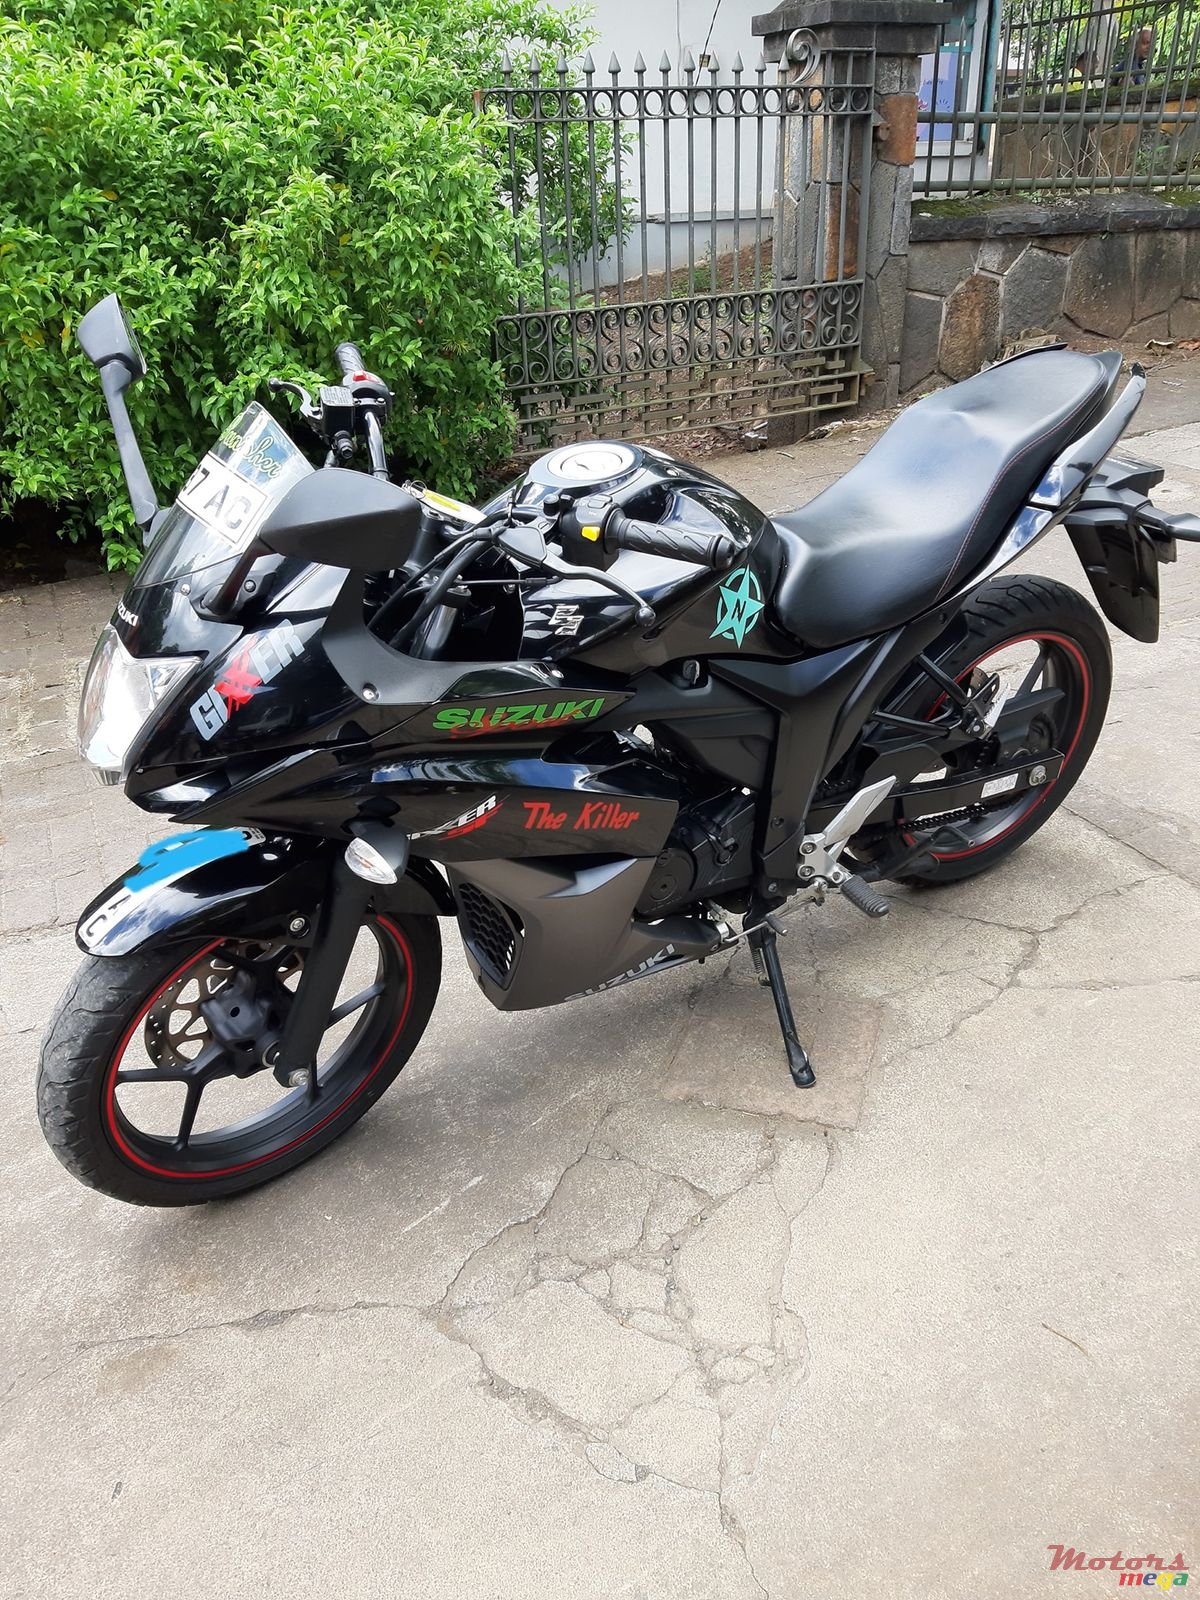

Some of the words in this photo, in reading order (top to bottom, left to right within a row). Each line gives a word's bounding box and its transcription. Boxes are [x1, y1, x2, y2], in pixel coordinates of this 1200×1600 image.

[432, 698, 605, 730] SUZUKI
[523, 802, 568, 830] The
[573, 802, 640, 830] Killer
